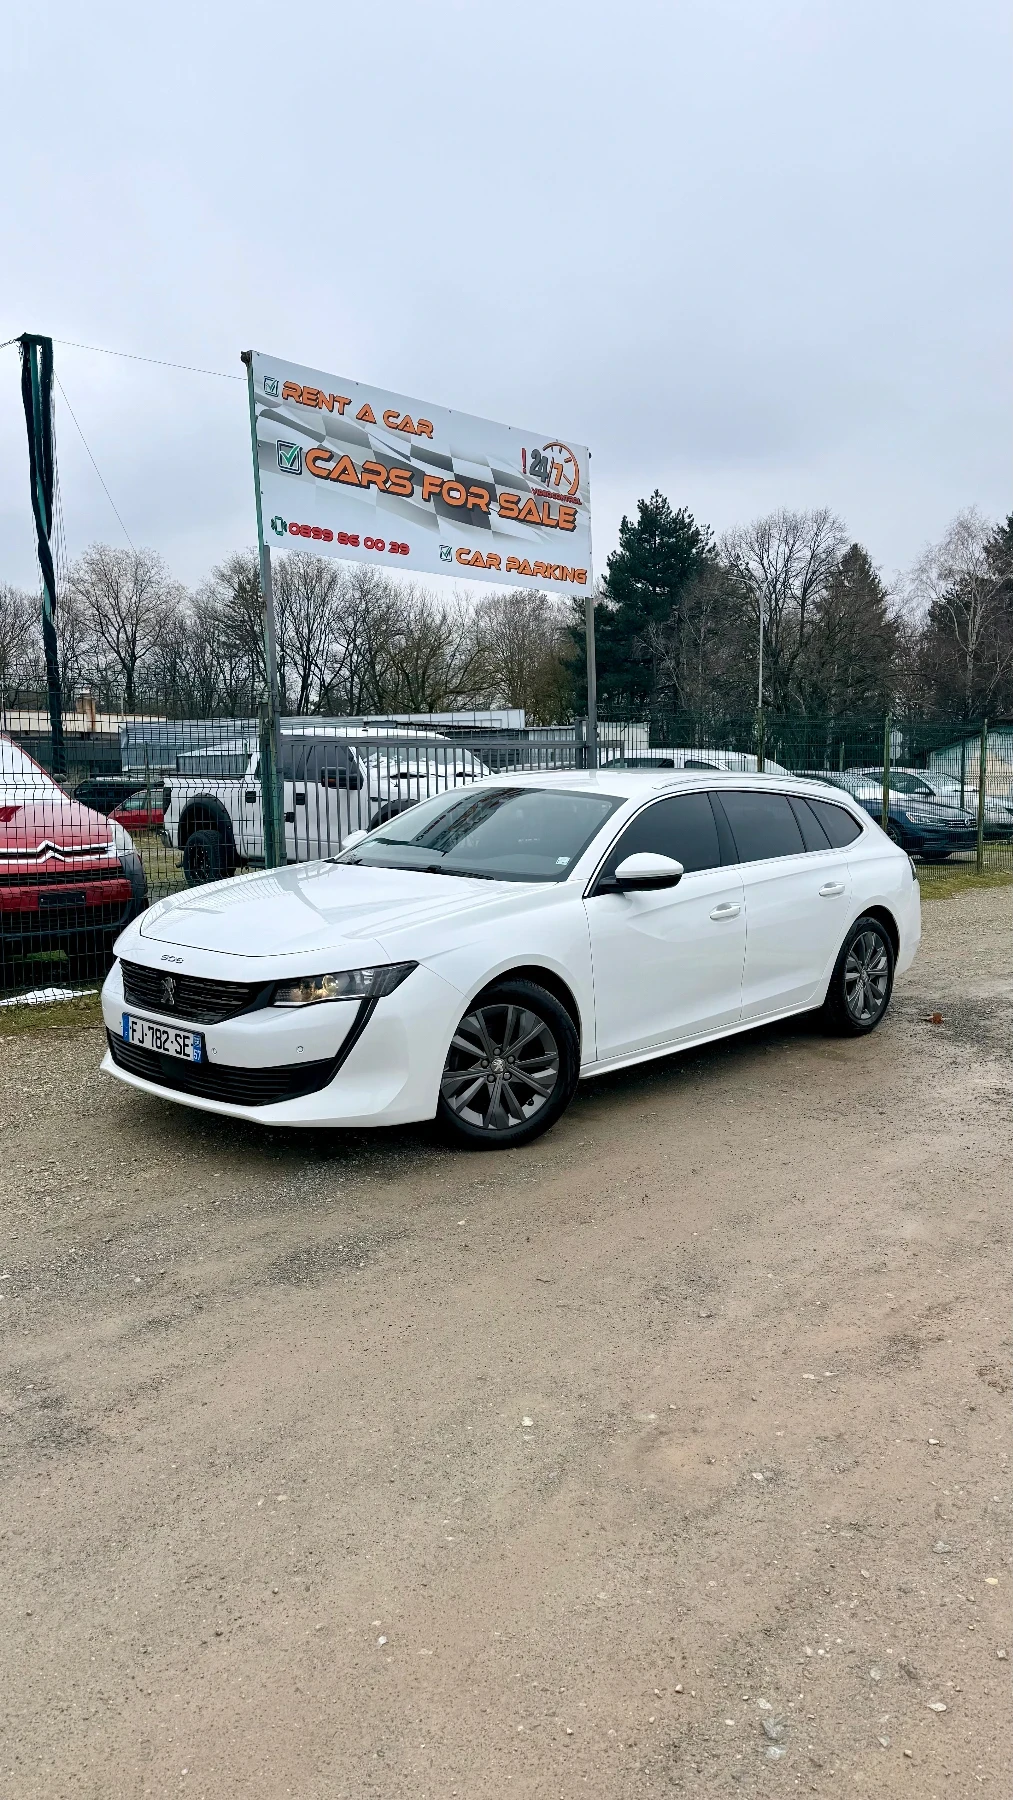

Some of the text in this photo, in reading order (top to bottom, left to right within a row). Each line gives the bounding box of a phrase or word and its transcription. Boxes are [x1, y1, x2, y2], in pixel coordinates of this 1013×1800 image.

[282, 381, 434, 439] RENT A CAR
[305, 447, 578, 533] CARS FOR SALE
[288, 522, 410, 556] 0899 86 00 39
[455, 547, 587, 586] CAR PARKING
[193, 1049, 202, 1061] 57
